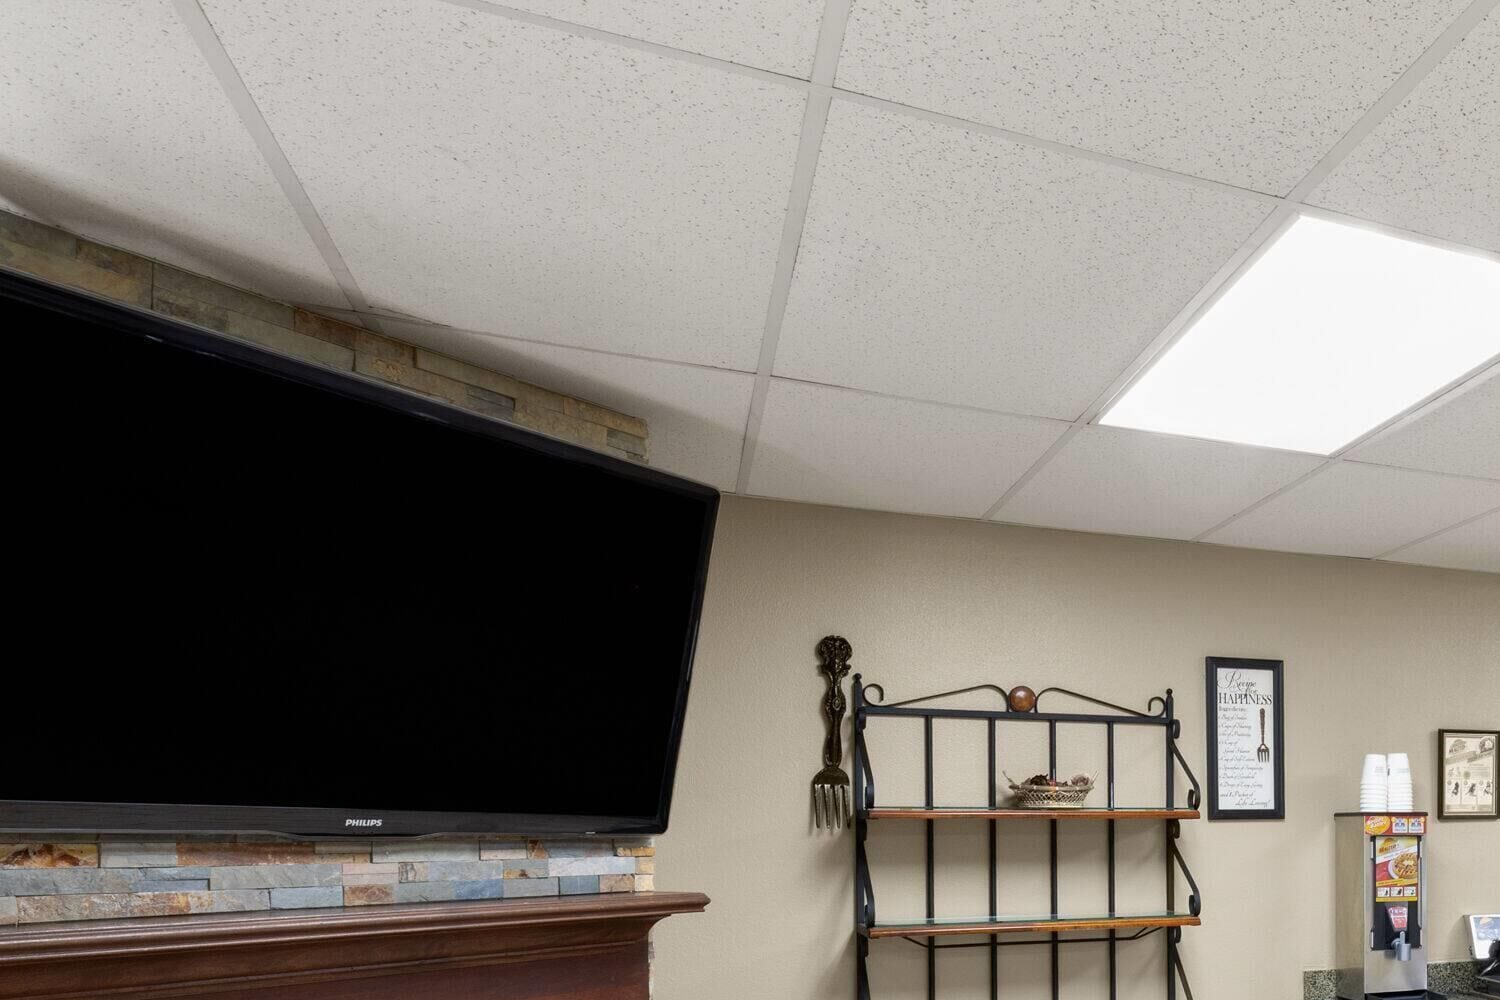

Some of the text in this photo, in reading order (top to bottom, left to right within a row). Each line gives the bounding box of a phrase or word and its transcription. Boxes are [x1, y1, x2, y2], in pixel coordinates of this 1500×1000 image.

[1217, 671, 1257, 693] Recipe
[1219, 692, 1273, 705] HAPPINESS
[345, 818, 383, 827] PHILIPS
